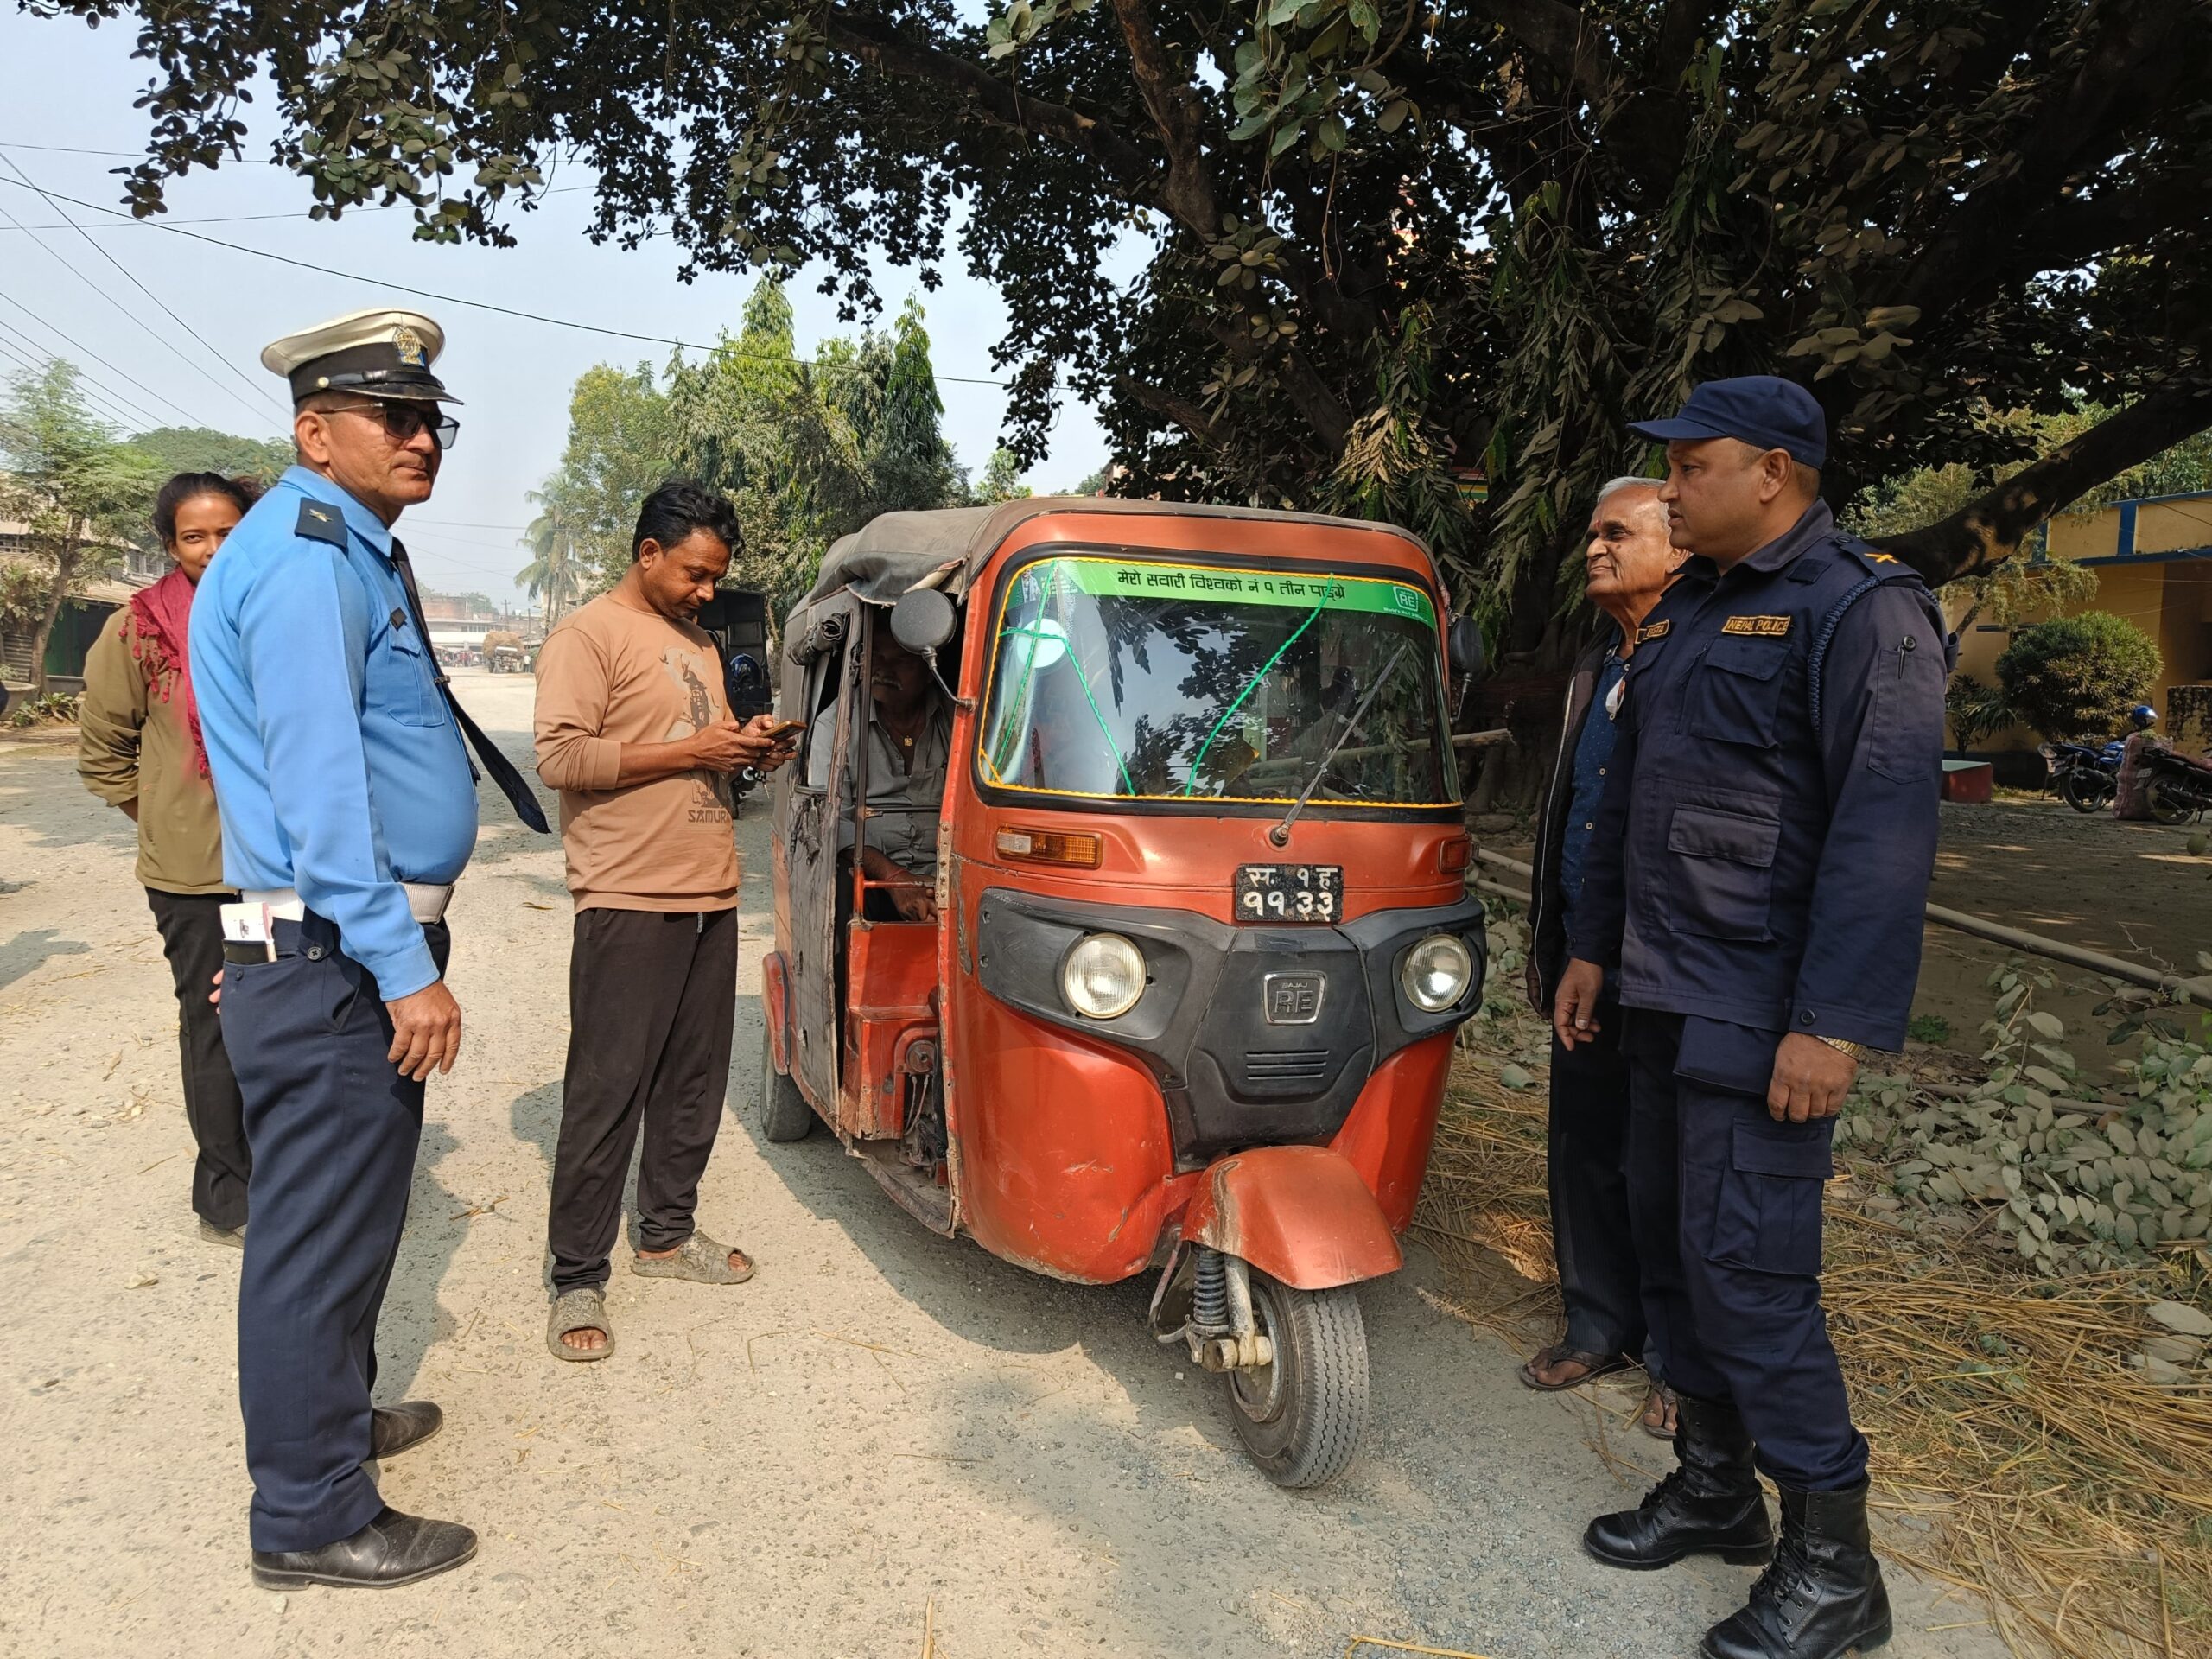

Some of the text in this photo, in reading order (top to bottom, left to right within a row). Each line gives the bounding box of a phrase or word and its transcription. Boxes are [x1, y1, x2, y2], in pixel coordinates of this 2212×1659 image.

[1117, 569, 1141, 586] मेरो
[1147, 573, 1185, 588] सवारी
[1189, 574, 1243, 592] विश्वको
[1247, 578, 1260, 594] नं
[1279, 580, 1306, 596] तीन
[1399, 594, 1415, 608] RE
[1727, 620, 1788, 632] NEPAL POLICE
[688, 809, 731, 823] SAMURA
[1243, 891, 1334, 922] ११३३
[1274, 990, 1313, 1014] RE
